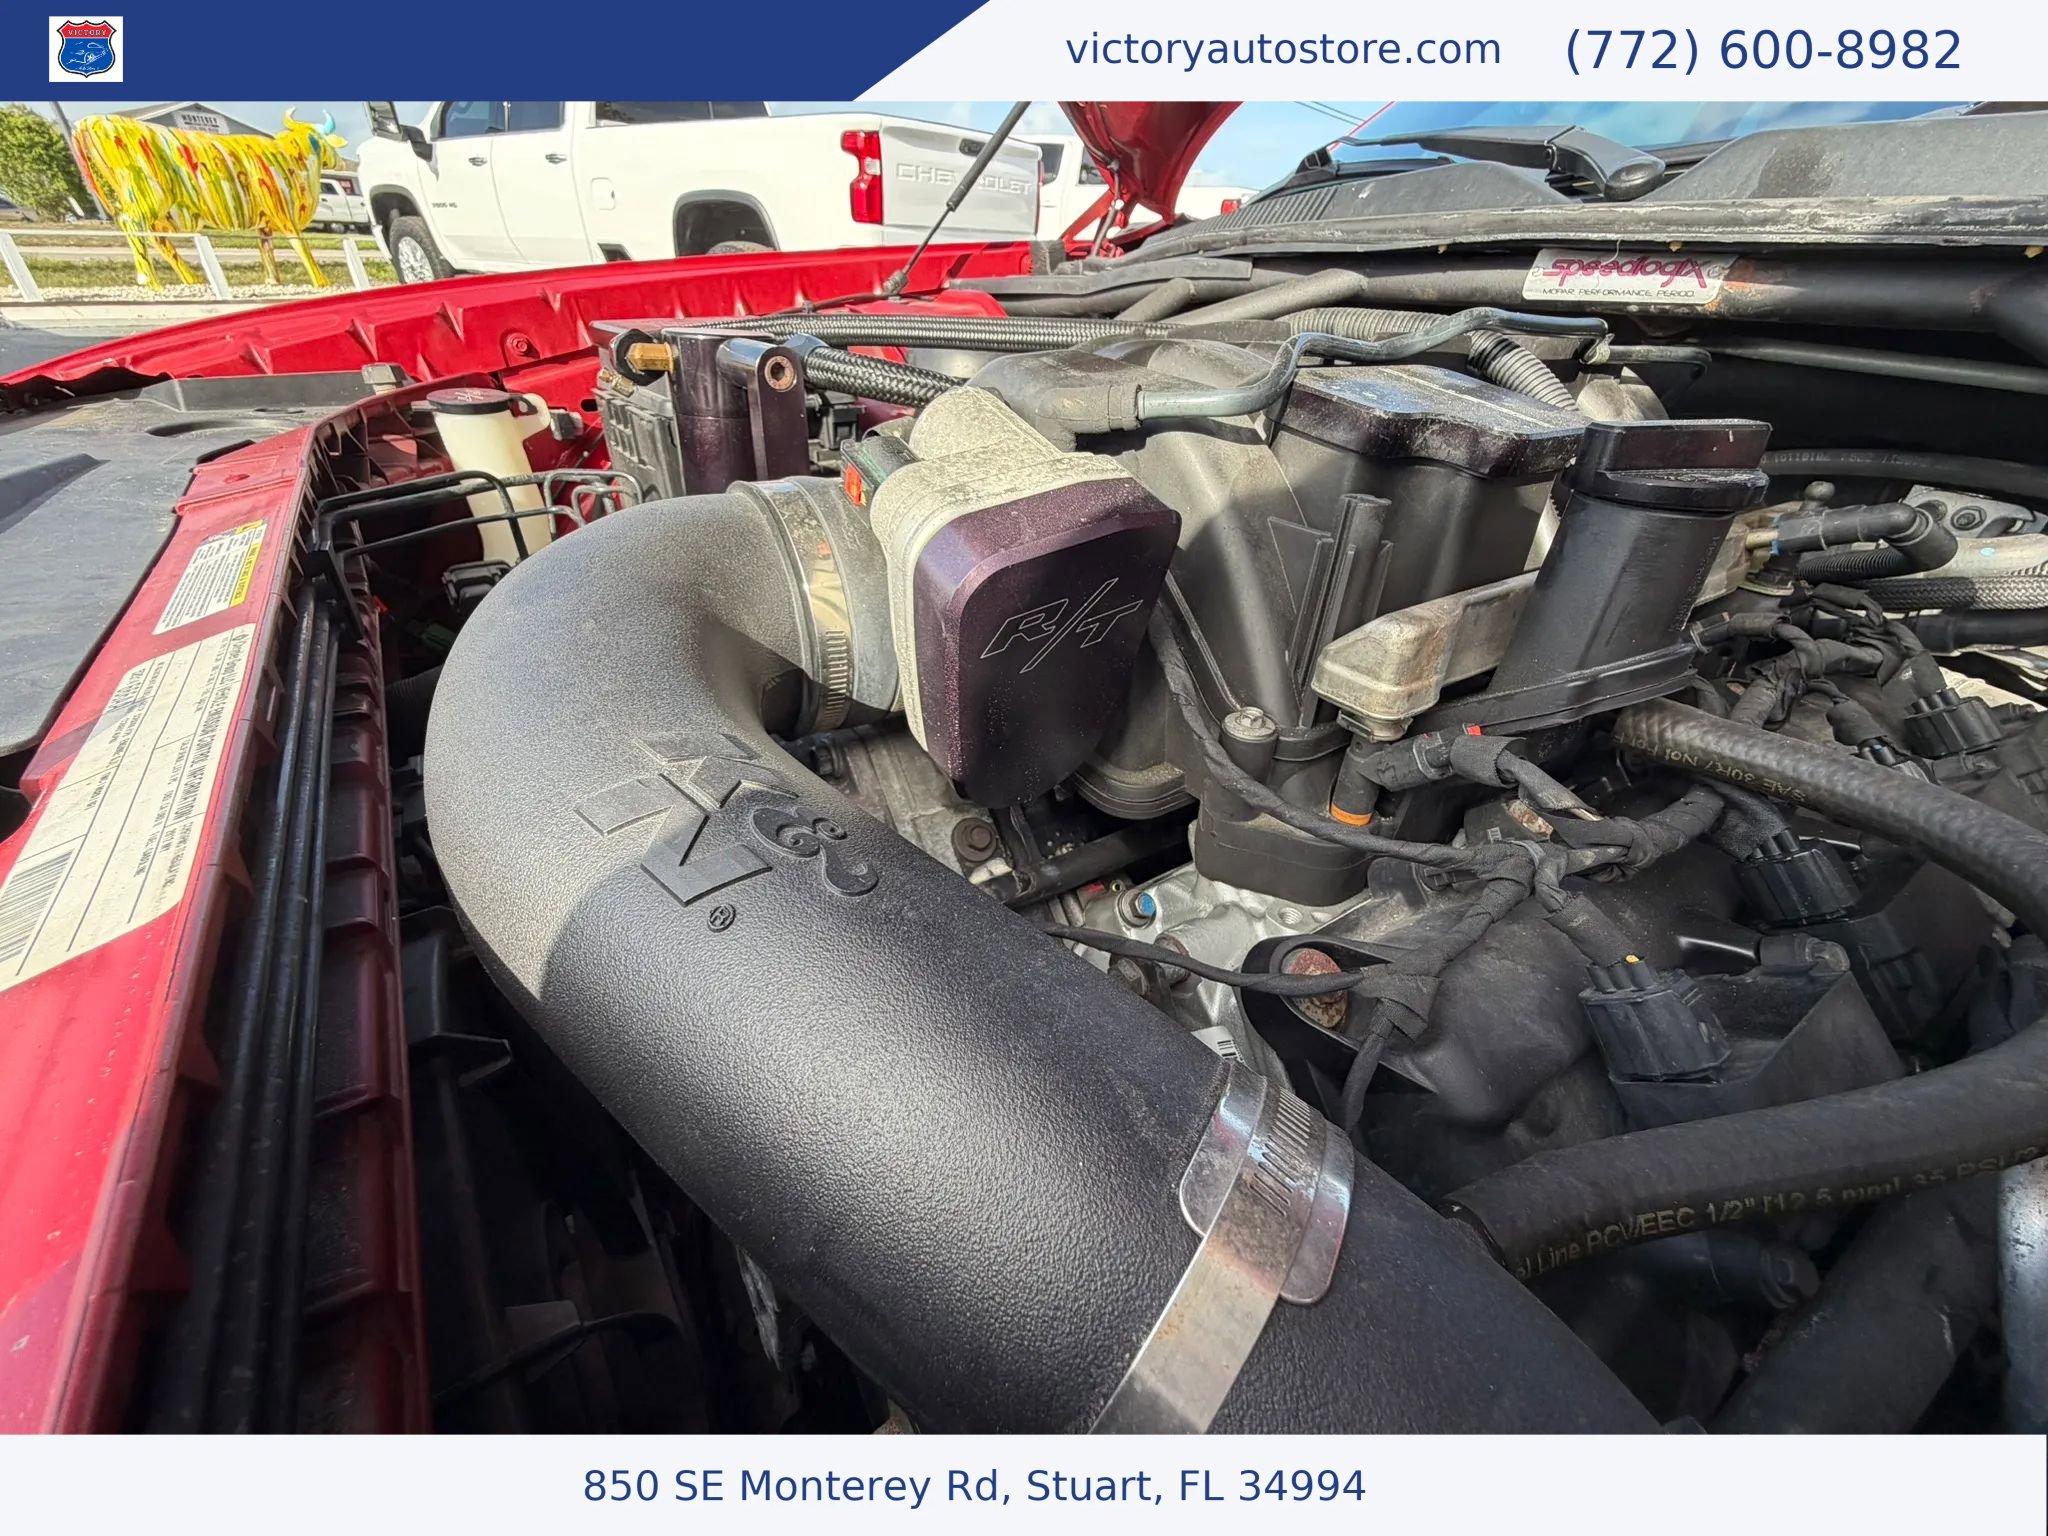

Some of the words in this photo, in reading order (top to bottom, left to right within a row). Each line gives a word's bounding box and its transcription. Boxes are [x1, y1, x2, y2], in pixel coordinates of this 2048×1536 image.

[895, 162, 1032, 195] CHEOLET
[1542, 288, 1575, 296] MOPAR
[1579, 288, 1652, 297] PERFORMANCE
[979, 577, 1144, 675] R/T
[188, 731, 216, 768] CONTROL
[173, 763, 206, 821] INFORMATION
[1762, 777, 1807, 803] SAE
[1537, 1240, 1581, 1274] Line
[1586, 1206, 1696, 1255] PCV/EEC
